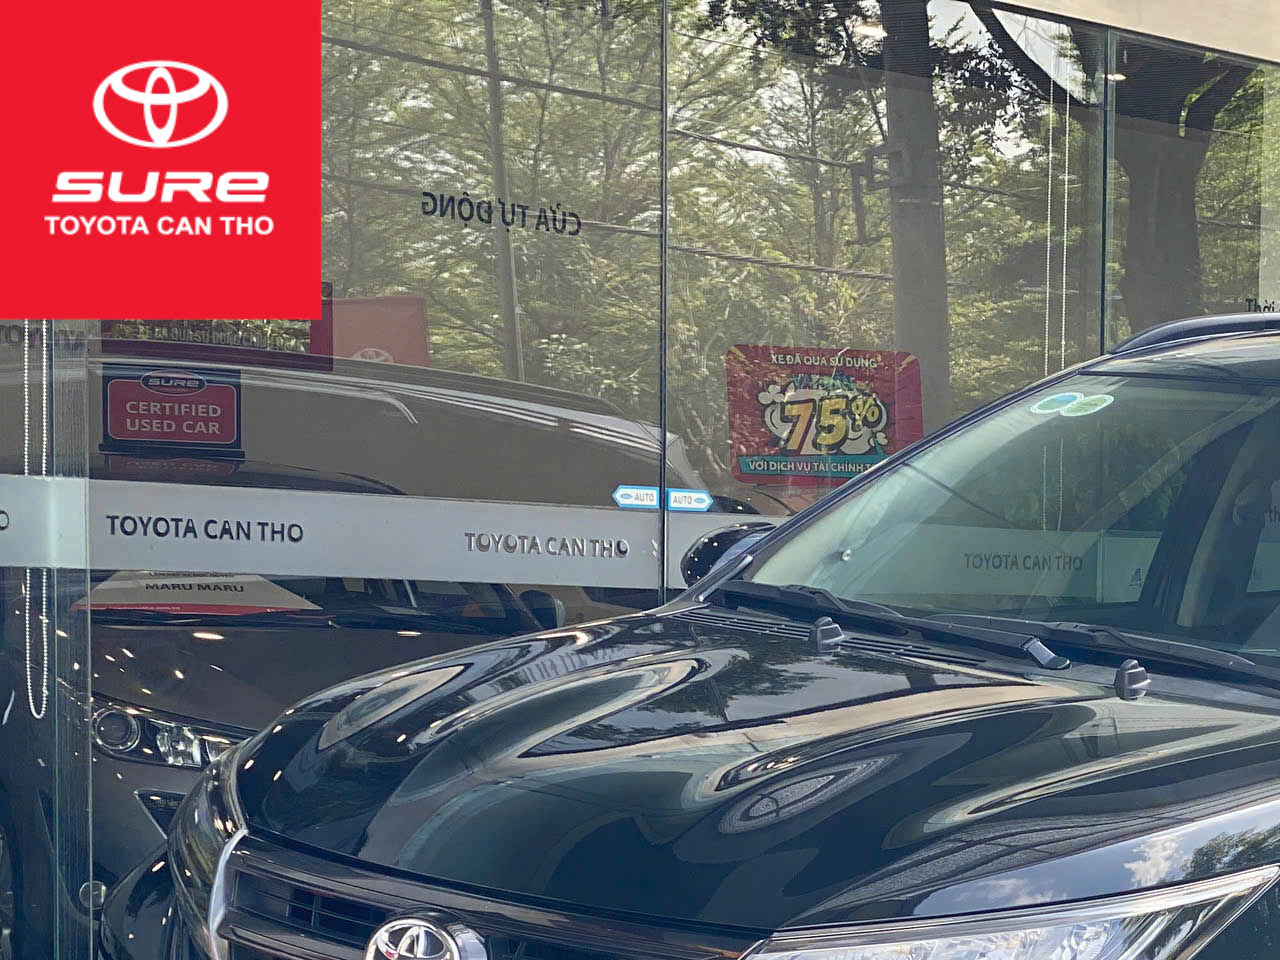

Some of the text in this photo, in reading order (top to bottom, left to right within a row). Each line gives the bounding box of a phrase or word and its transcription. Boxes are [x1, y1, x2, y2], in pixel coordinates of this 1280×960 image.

[771, 354, 785, 364] XE
[803, 356, 827, 367] QUA
[125, 401, 222, 418] CERTIFIED
[126, 418, 221, 435] USED CAR
[783, 395, 881, 450] 75%
[748, 459, 767, 470] VỚI
[769, 461, 795, 473] DỊCH
[796, 461, 811, 473] VỤ
[813, 461, 829, 472] TÀI
[831, 461, 863, 473] CHÍNH
[634, 493, 655, 502] AUTO
[672, 495, 693, 504] AUTO
[106, 515, 304, 543] TOYOTA CAN THO
[464, 532, 630, 559] TOYOTA CAN THO
[963, 553, 1083, 572] TOYOTA CAN THO
[145, 583, 244, 593] MARU MARU
